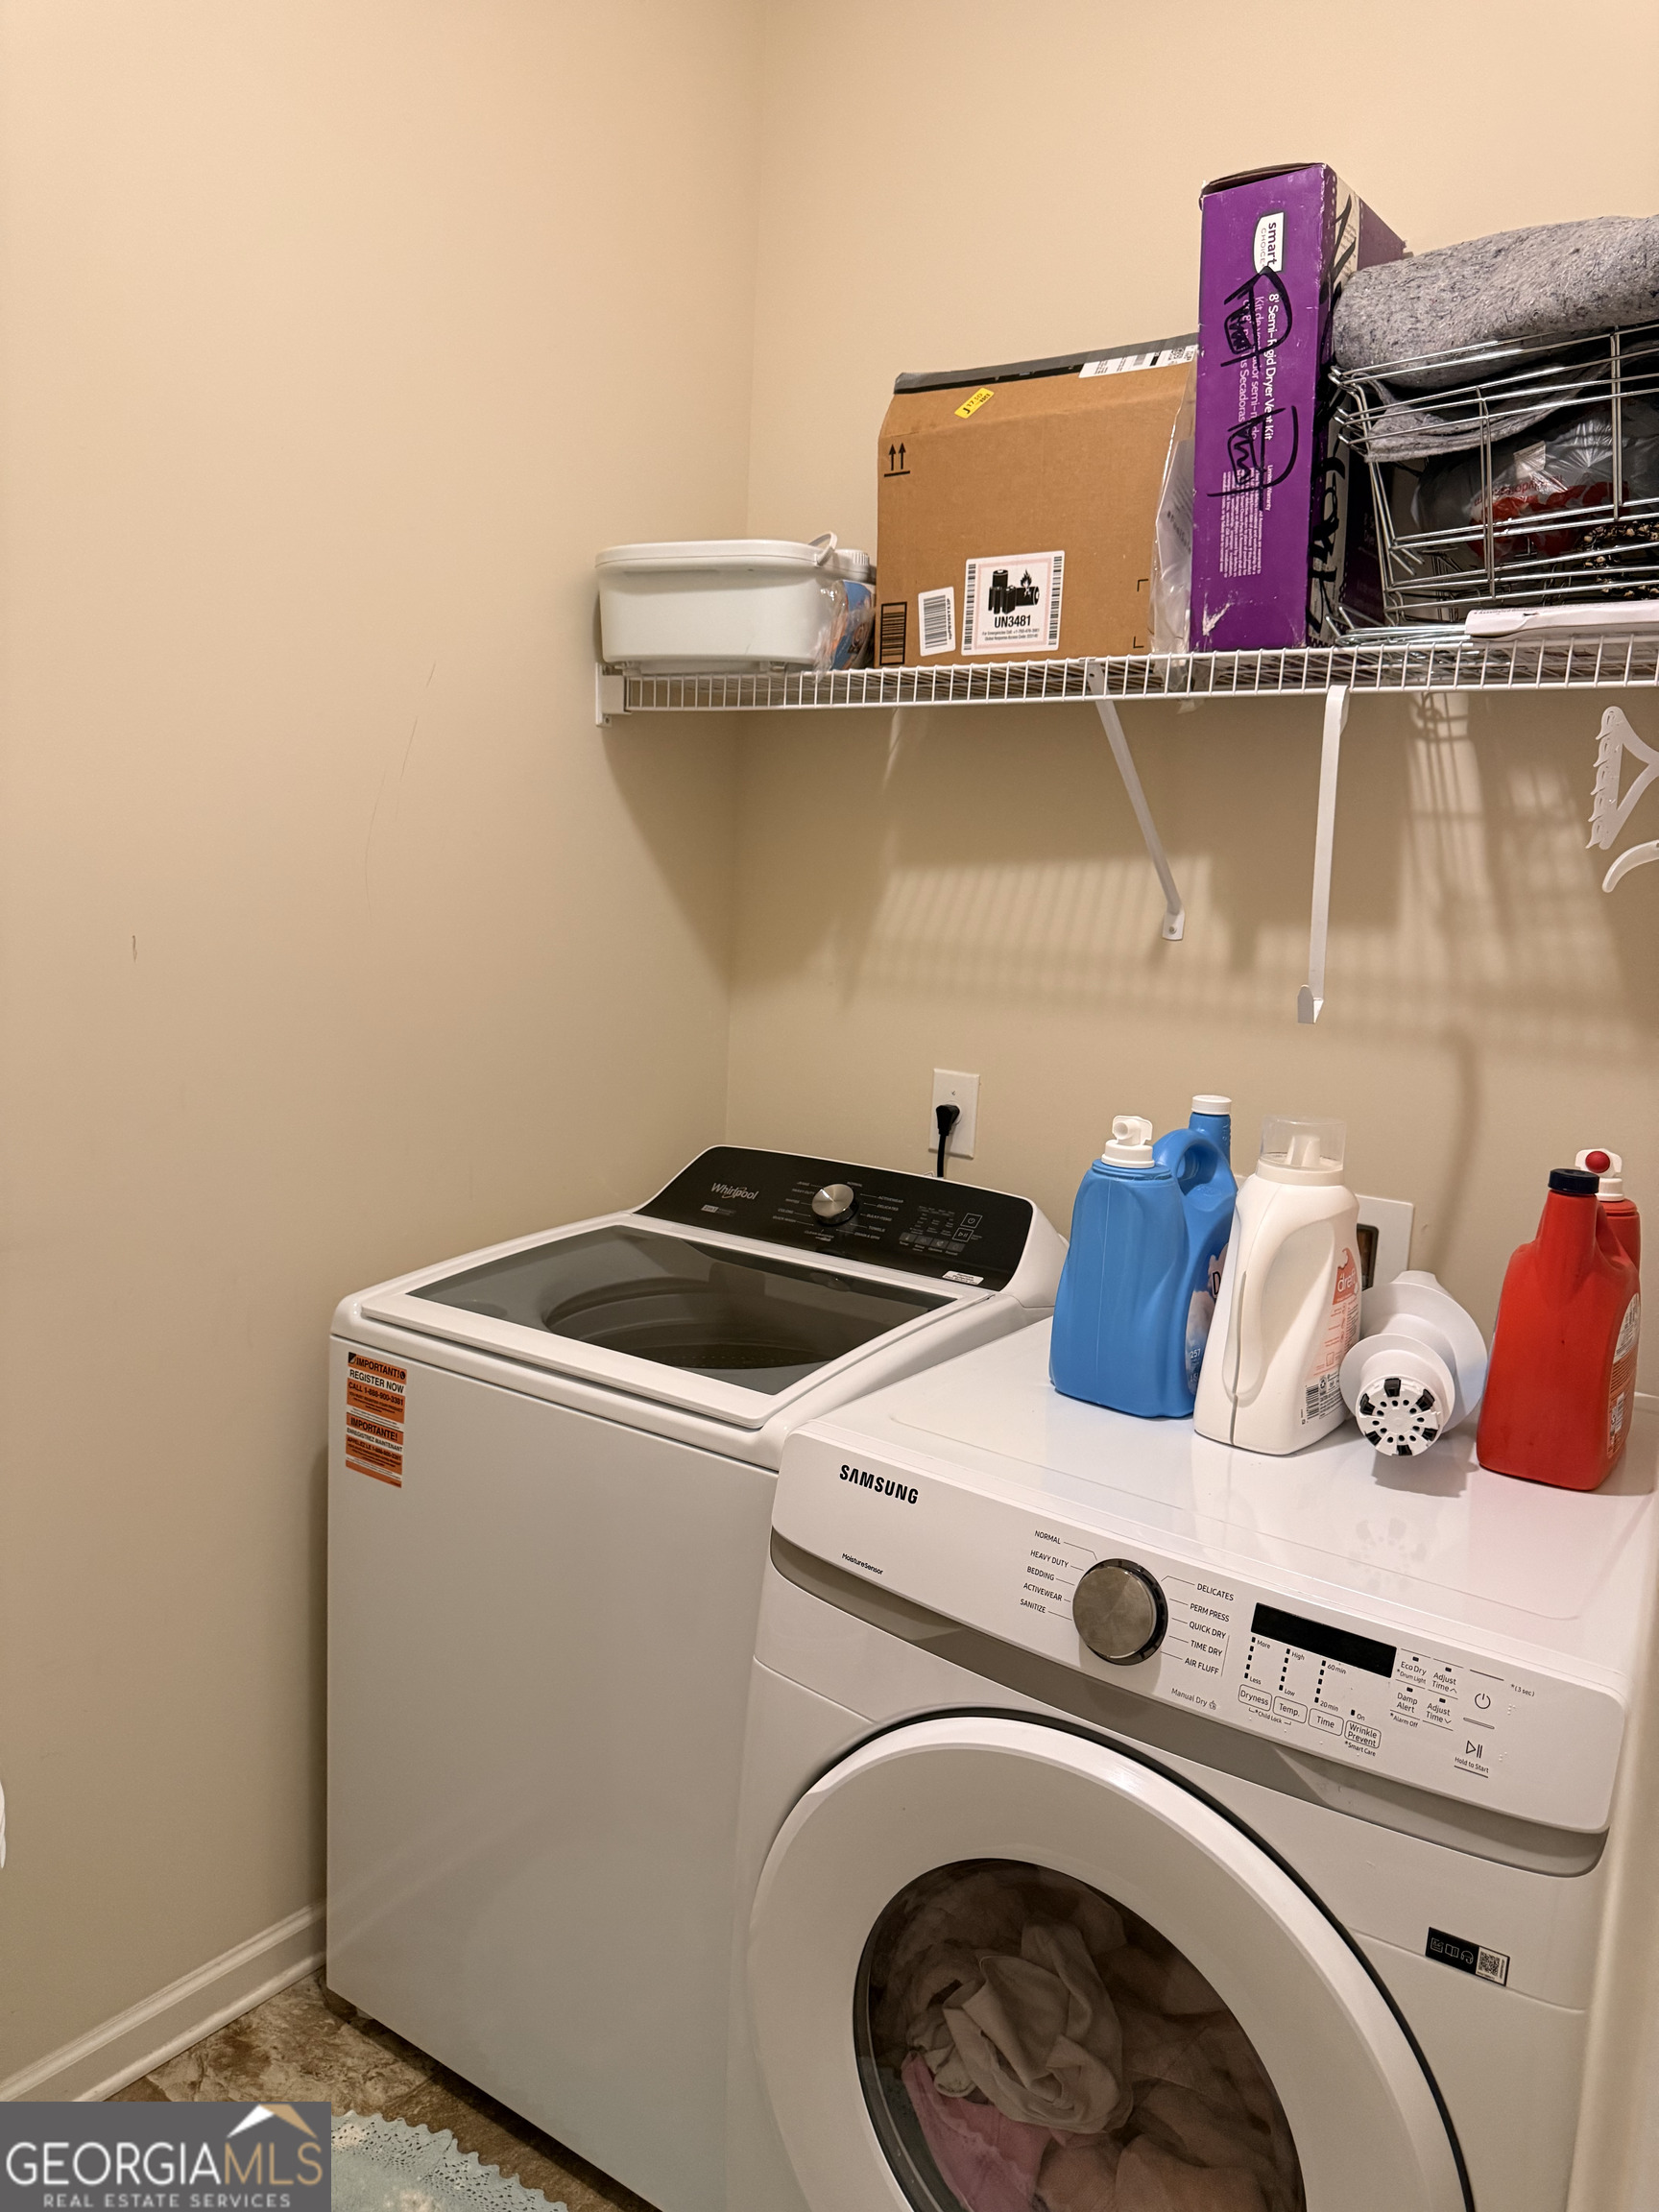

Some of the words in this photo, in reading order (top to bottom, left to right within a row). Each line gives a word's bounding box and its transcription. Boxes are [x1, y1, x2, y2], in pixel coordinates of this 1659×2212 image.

[1267, 222, 1277, 266] smart
[1254, 296, 1264, 312] Kit
[1262, 367, 1276, 397] Dryer
[1238, 369, 1250, 422] Secadoras
[1264, 424, 1275, 441] Kit
[994, 614, 1031, 628] UN3481
[710, 1182, 759, 1200] Whirlpool
[356, 1357, 400, 1378] IMPORTANT!
[349, 1369, 385, 1388] REGISTER
[386, 1381, 404, 1393] NOW
[349, 1382, 363, 1392] CALL
[839, 1464, 919, 1504] SAMSUNG
[1034, 1529, 1062, 1545] NORMAL
[1030, 1550, 1052, 1562] HEAVY
[1051, 1556, 1070, 1568] DUTY
[1026, 1565, 1055, 1581] BEDDING
[1022, 1582, 1063, 1601] ACTIVEWEAR
[1196, 1583, 1235, 1601] DELICATES
[1020, 1598, 1046, 1614] SANITIZE
[1190, 1602, 1209, 1616] PERM
[1209, 1609, 1230, 1623] PRESS
[1189, 1621, 1211, 1634] QUICK
[1211, 1628, 1227, 1640] DRY
[1190, 1639, 1207, 1652] TIME
[1208, 1646, 1223, 1657] DRY
[1257, 1639, 1271, 1649] More
[1291, 1650, 1306, 1661] High
[1184, 1657, 1197, 1669] AIR
[1197, 1661, 1219, 1675] FLUFF
[1249, 1675, 1262, 1685] Less
[1413, 1674, 1427, 1685] Light
[1432, 1671, 1456, 1685] Adjust
[1285, 1688, 1296, 1696] Low
[1431, 1680, 1450, 1693] Time
[1170, 1687, 1195, 1702] Manual
[1195, 1695, 1208, 1708] Dry
[1239, 1690, 1269, 1706] Dryness
[1397, 1692, 1418, 1706] Damp
[1279, 1702, 1300, 1718] Temp.
[1396, 1701, 1415, 1714] Alert
[1427, 1702, 1451, 1717] Adjust
[1270, 1714, 1283, 1724] Lock
[1316, 1716, 1335, 1729] Time
[1357, 1713, 1365, 1721] On
[1408, 1719, 1418, 1729] Off
[1426, 1710, 1444, 1723] Time
[1349, 1722, 1378, 1739] Wrinkle
[1347, 1731, 1377, 1747] Prevent
[1364, 1747, 1377, 1757] Care
[1455, 1756, 1468, 1767] Hold
[1475, 1763, 1489, 1773] Start
